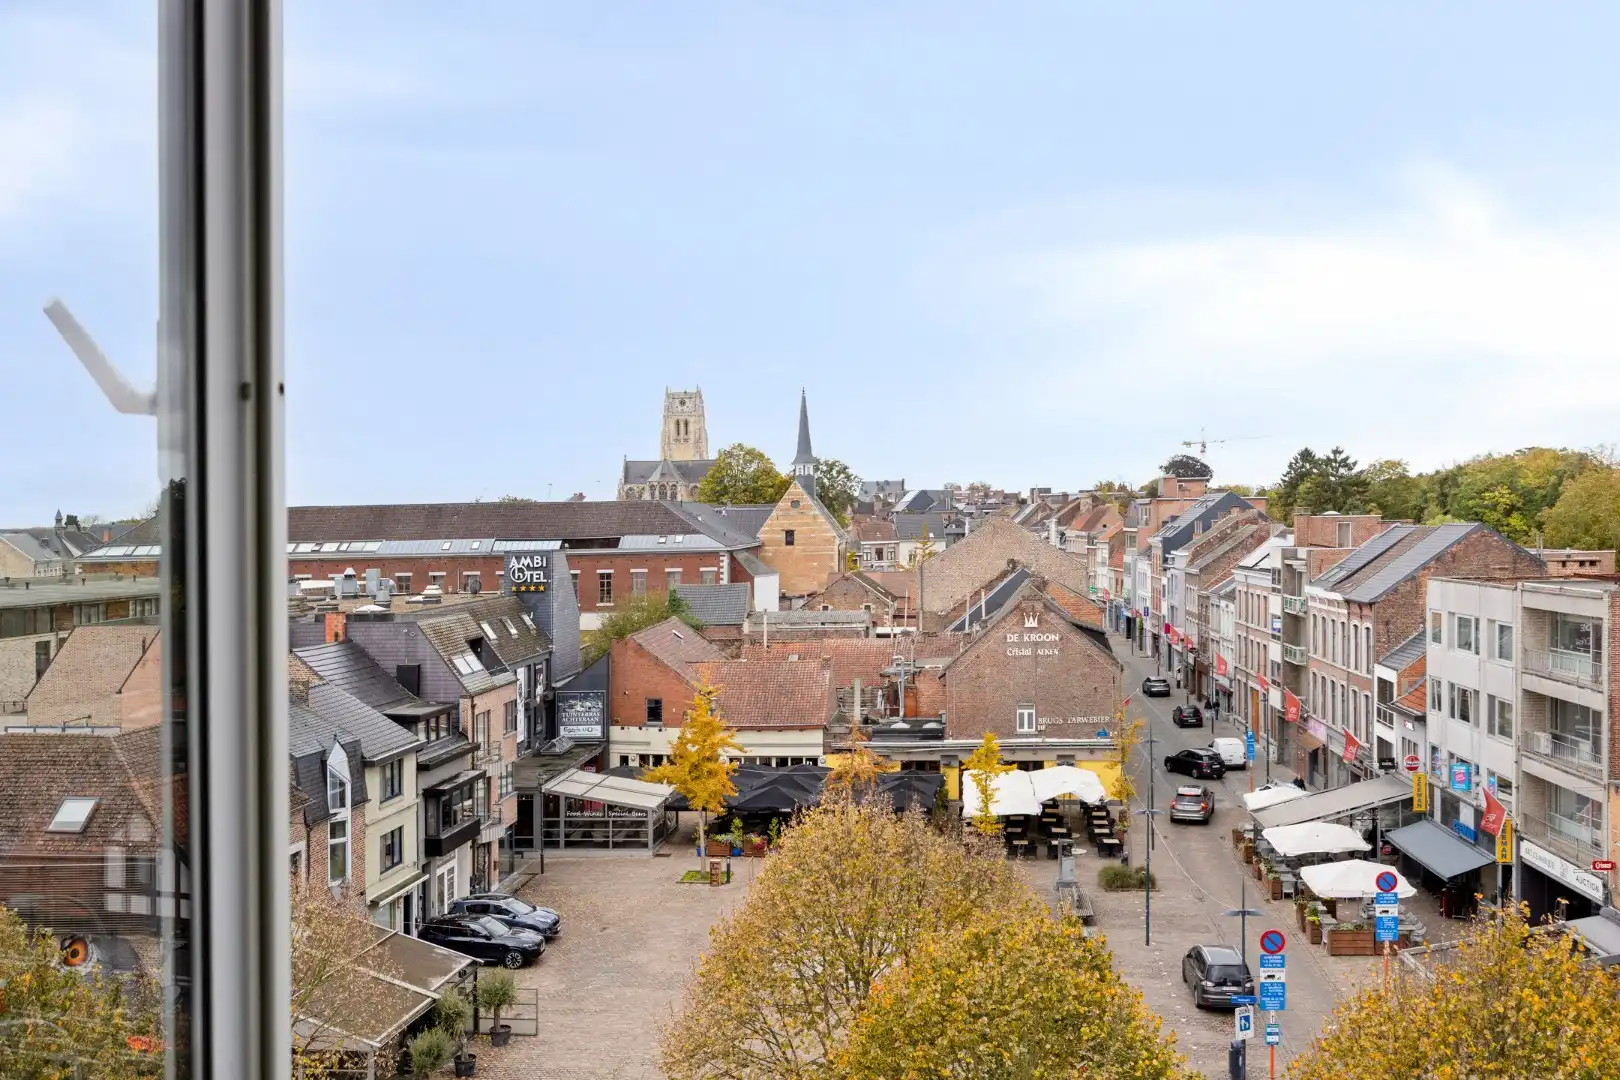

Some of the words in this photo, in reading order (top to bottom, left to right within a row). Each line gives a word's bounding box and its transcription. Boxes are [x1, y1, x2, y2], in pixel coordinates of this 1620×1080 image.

[509, 555, 547, 568] AMBI
[1006, 633, 1019, 642] DE
[1023, 633, 1059, 642] KROON
[1006, 647, 1032, 656] Cristal
[1038, 717, 1064, 725] BRUGS
[1067, 716, 1111, 725] TARWEBIER
[1575, 875, 1600, 893] AUCTION
